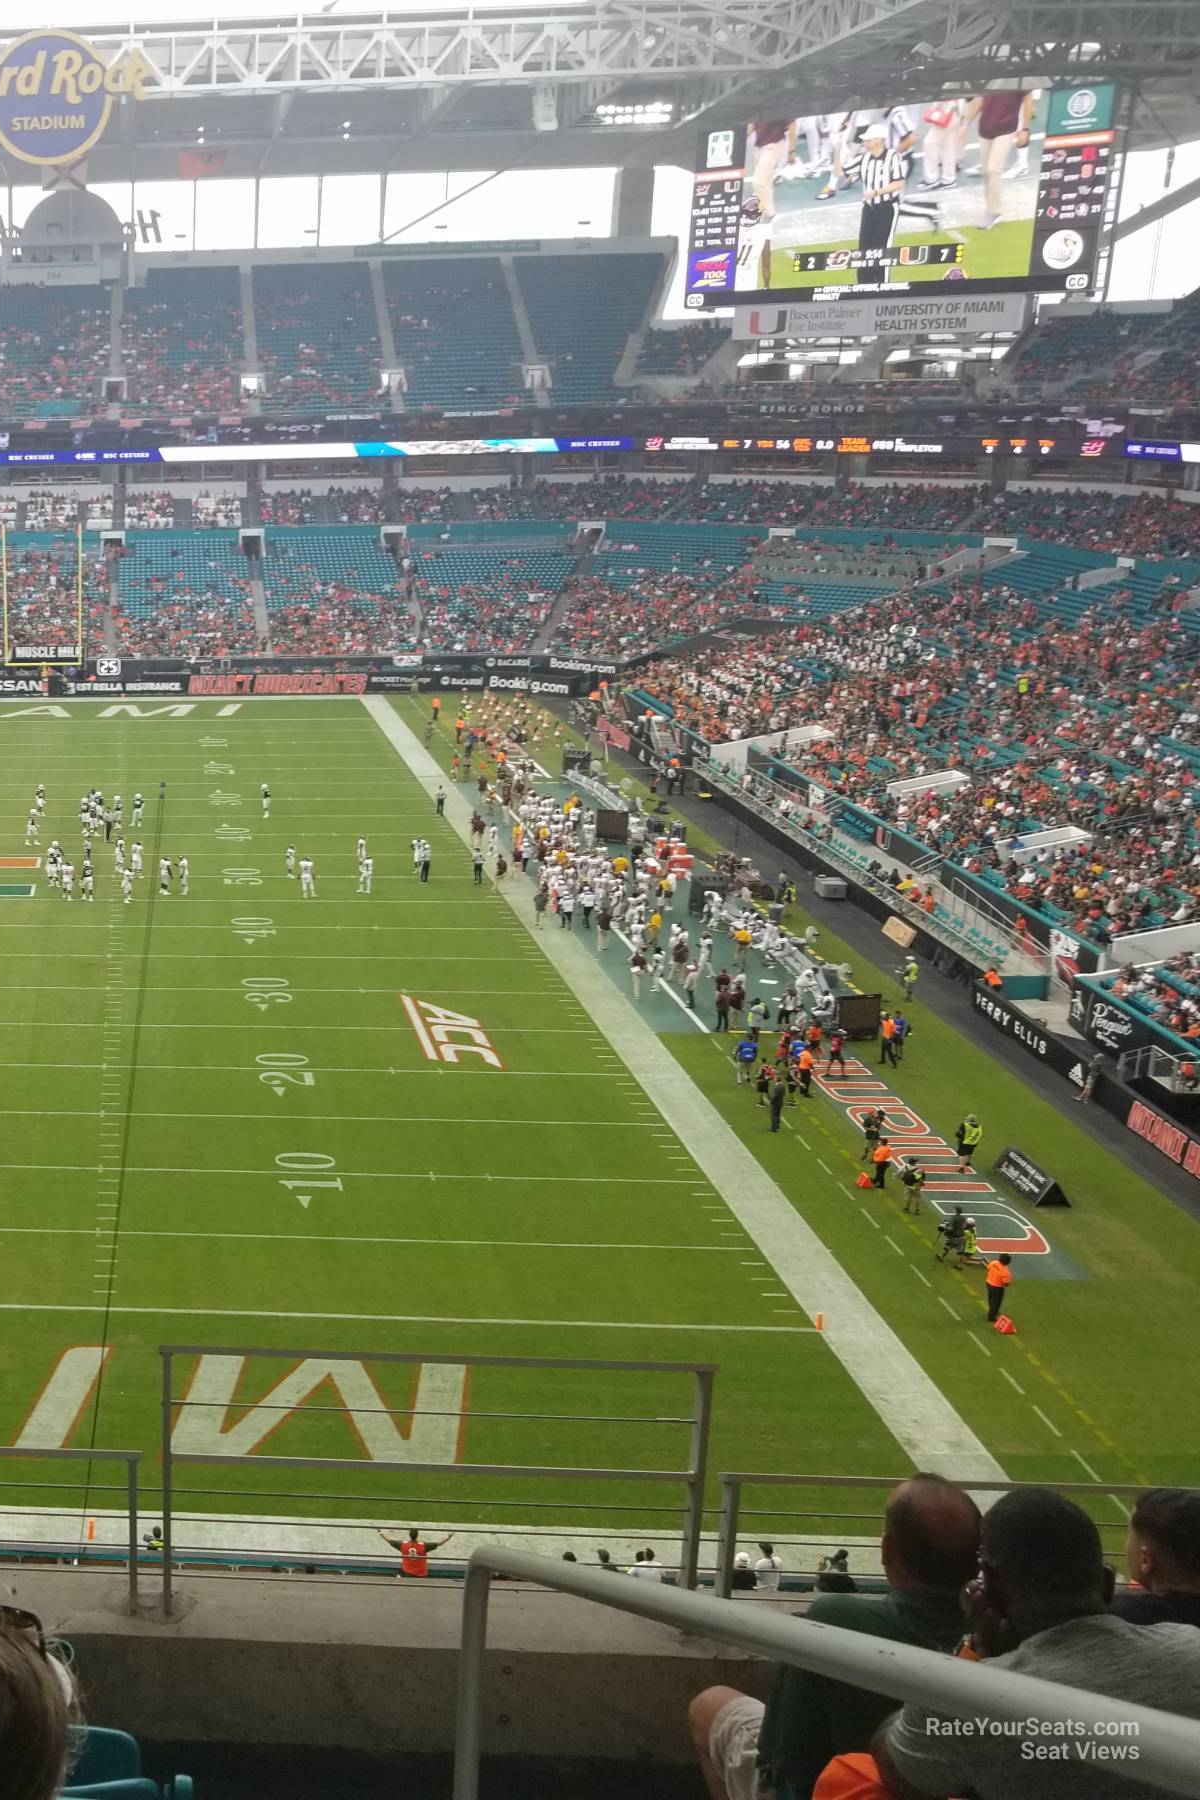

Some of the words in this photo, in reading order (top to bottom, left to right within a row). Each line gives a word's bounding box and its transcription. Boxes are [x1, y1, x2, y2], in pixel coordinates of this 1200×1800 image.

[50, 48, 151, 104] Rock
[11, 114, 86, 131] STADIUM
[807, 257, 815, 269] 2
[865, 249, 883, 259] 9:14
[940, 248, 949, 261] 7
[703, 270, 727, 279] TOOL
[1068, 277, 1085, 287] CC
[789, 309, 826, 320] Bascom
[828, 308, 863, 319] Palmer
[875, 302, 944, 316] UNIVERSITY
[947, 302, 961, 314] OF
[964, 301, 1005, 313] MIAMI
[788, 321, 806, 332] Eye
[807, 319, 846, 331] Institute
[874, 319, 918, 331] HEALTH
[921, 317, 967, 330] SYSTEM
[744, 440, 752, 449] 7
[776, 440, 790, 449] 56
[16, 646, 55, 657] MUSCLE
[100, 660, 117, 673] 25
[550, 657, 616, 674] Booking.com
[76, 682, 123, 692] ESTRELLA
[976, 991, 1011, 1026] PERRY
[1014, 1020, 1047, 1055] ELLIS
[1090, 1002, 1133, 1036] Penguin
[416, 999, 504, 1070] ACC
[1126, 1100, 1188, 1164] MIAMI
